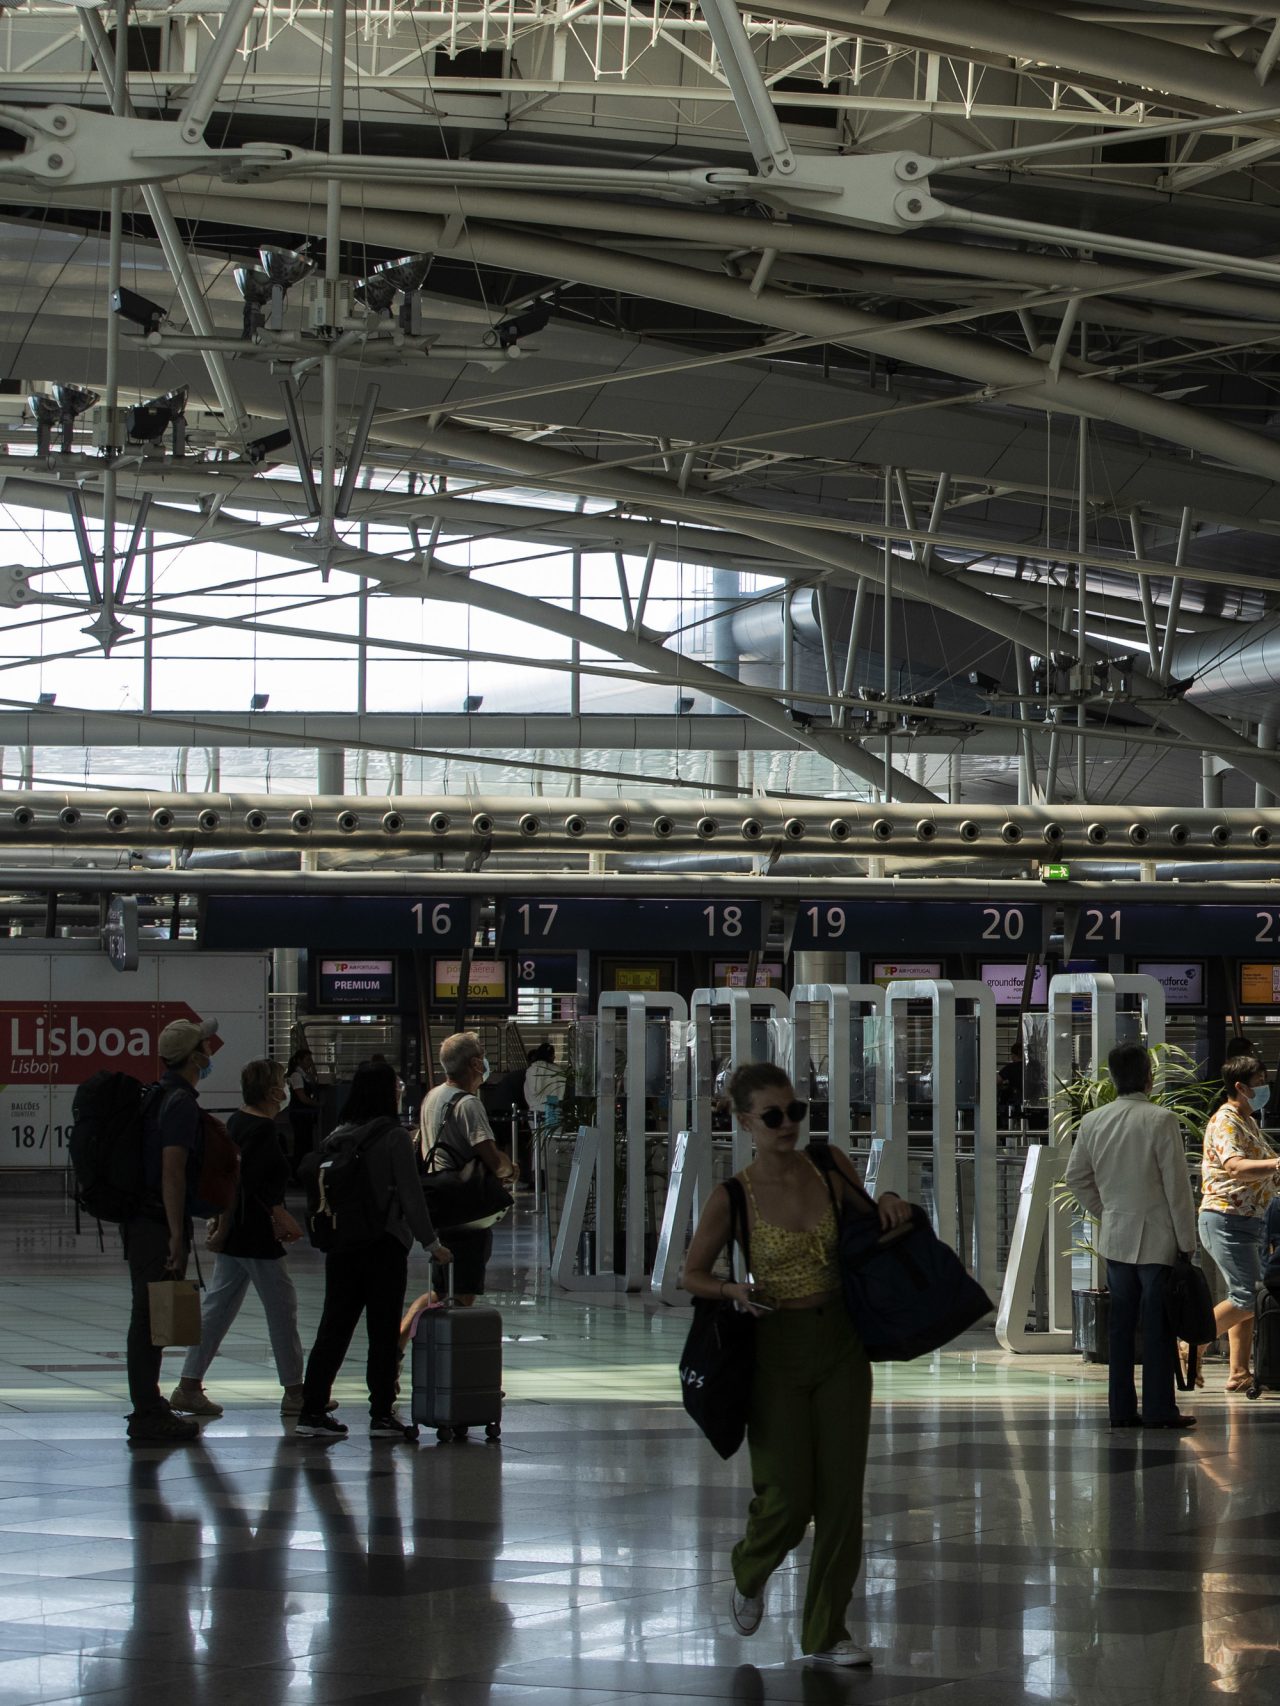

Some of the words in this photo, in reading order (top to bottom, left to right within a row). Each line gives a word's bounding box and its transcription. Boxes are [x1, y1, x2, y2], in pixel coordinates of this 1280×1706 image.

[411, 902, 451, 935] 16
[518, 903, 559, 935] 17
[702, 905, 743, 936] 18
[807, 906, 846, 938] 19
[981, 908, 1024, 940] 20
[1085, 909, 1122, 941] 21
[334, 981, 380, 990] PREMIUM
[987, 977, 1026, 988] groundfor
[11, 1016, 150, 1057] Lisboa
[10, 1059, 59, 1075] Lisbon
[12, 1125, 35, 1148] 18
